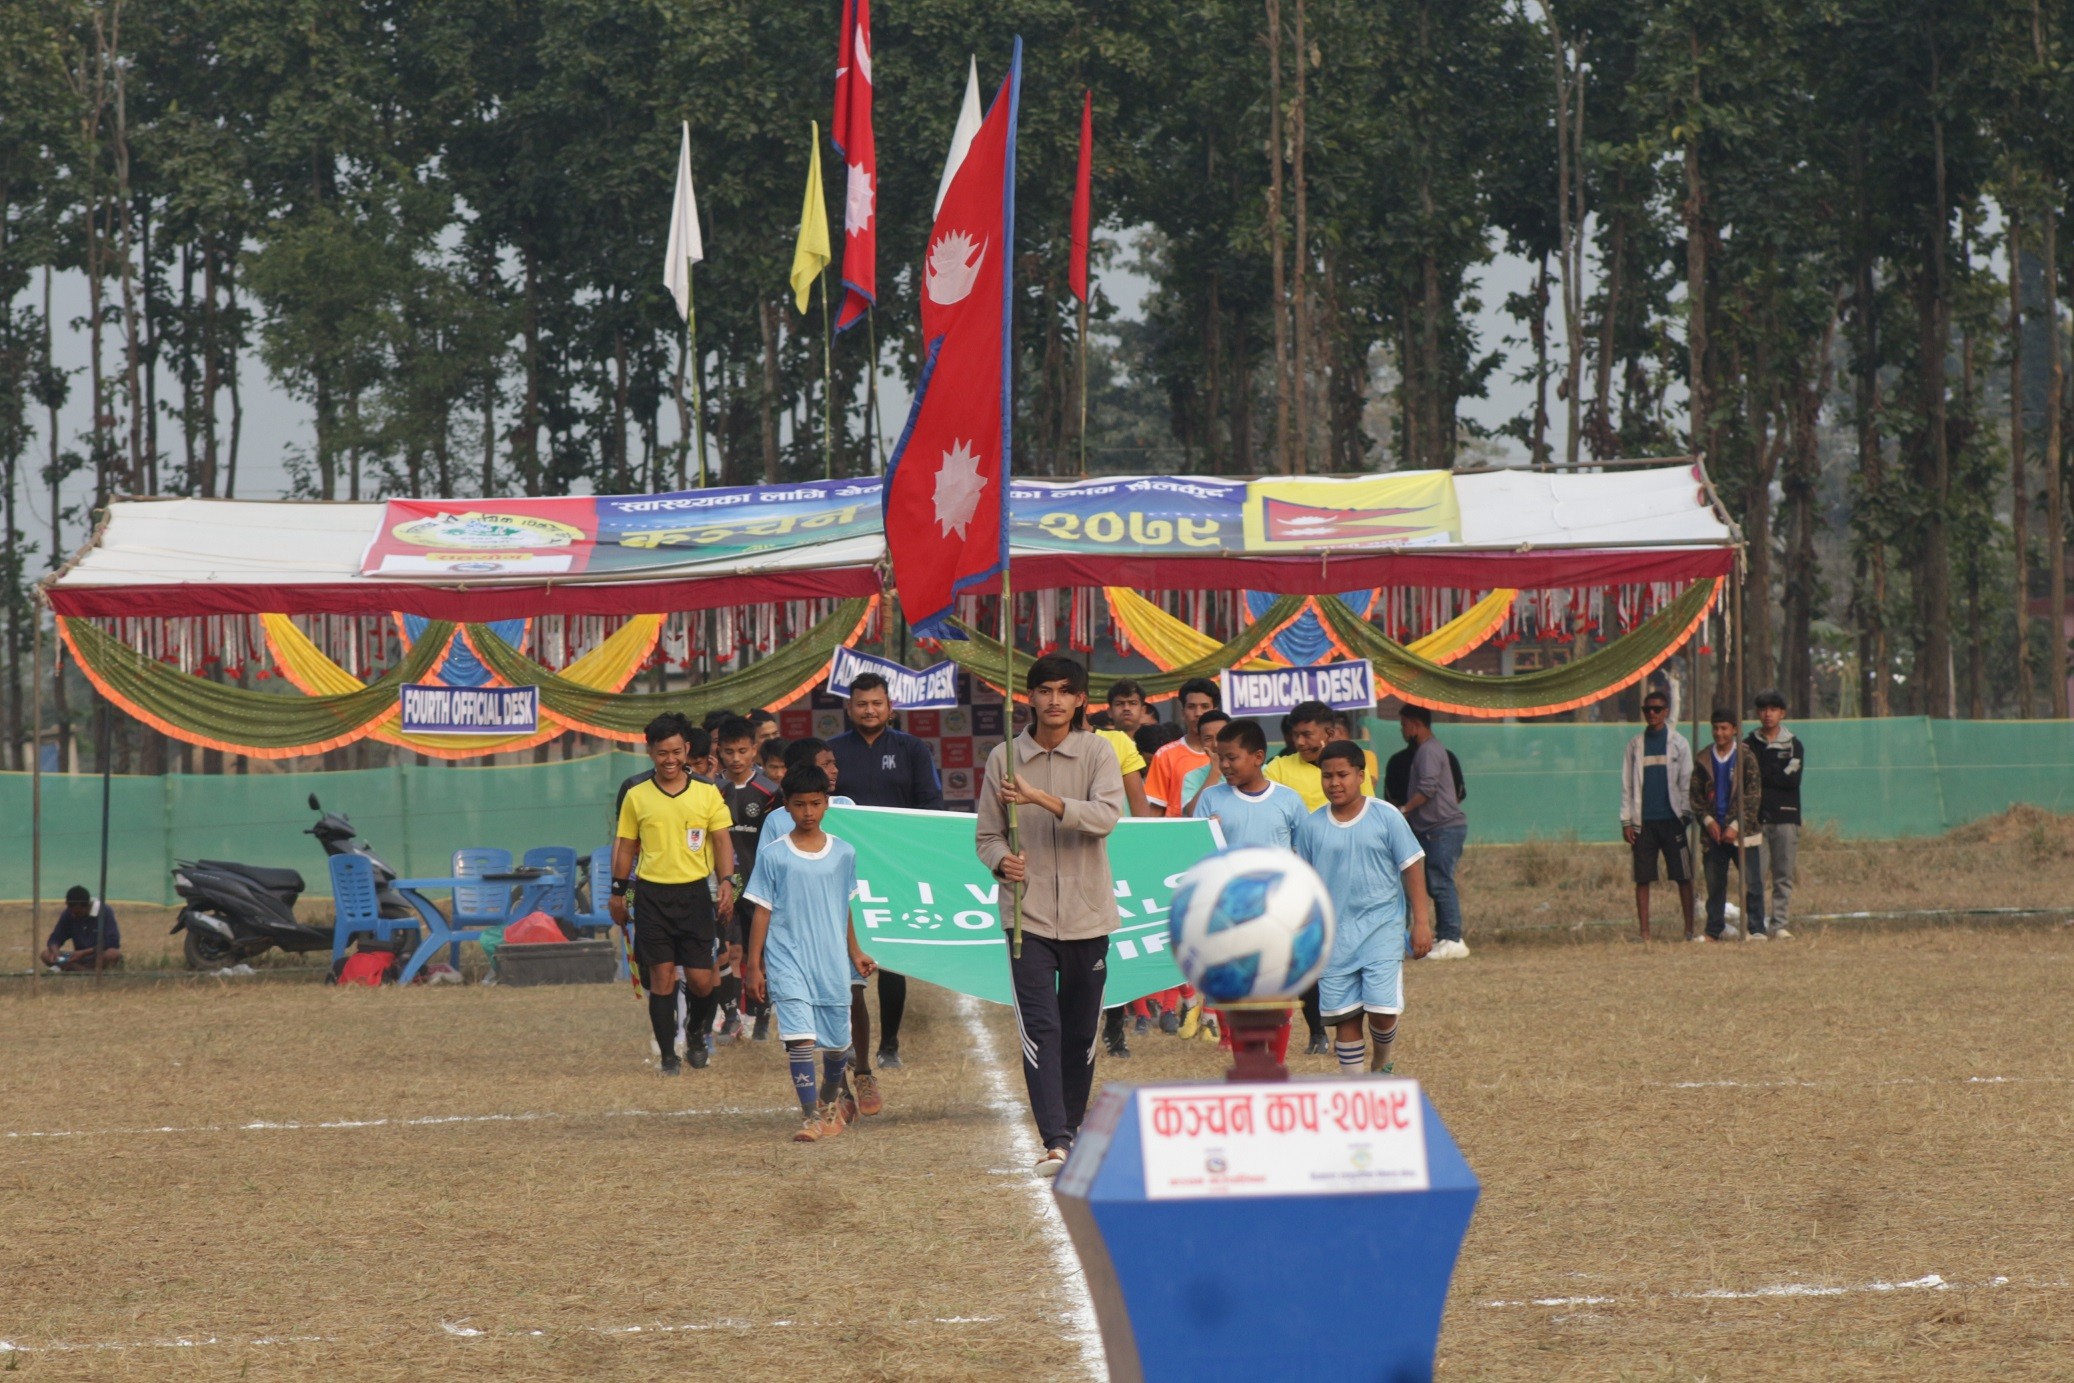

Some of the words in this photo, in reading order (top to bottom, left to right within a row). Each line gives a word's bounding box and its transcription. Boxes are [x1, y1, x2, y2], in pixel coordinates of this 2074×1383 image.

[760, 488, 828, 502] लागि
[926, 663, 955, 699] DESK
[1232, 671, 1315, 708] MEDICAL
[1315, 667, 1366, 703] DESK
[404, 689, 451, 725] FOURTH
[451, 690, 502, 726] OFFICIAL
[503, 690, 533, 725] DESK
[882, 754, 896, 770] AK
[1150, 1092, 1255, 1138] कञ्चन
